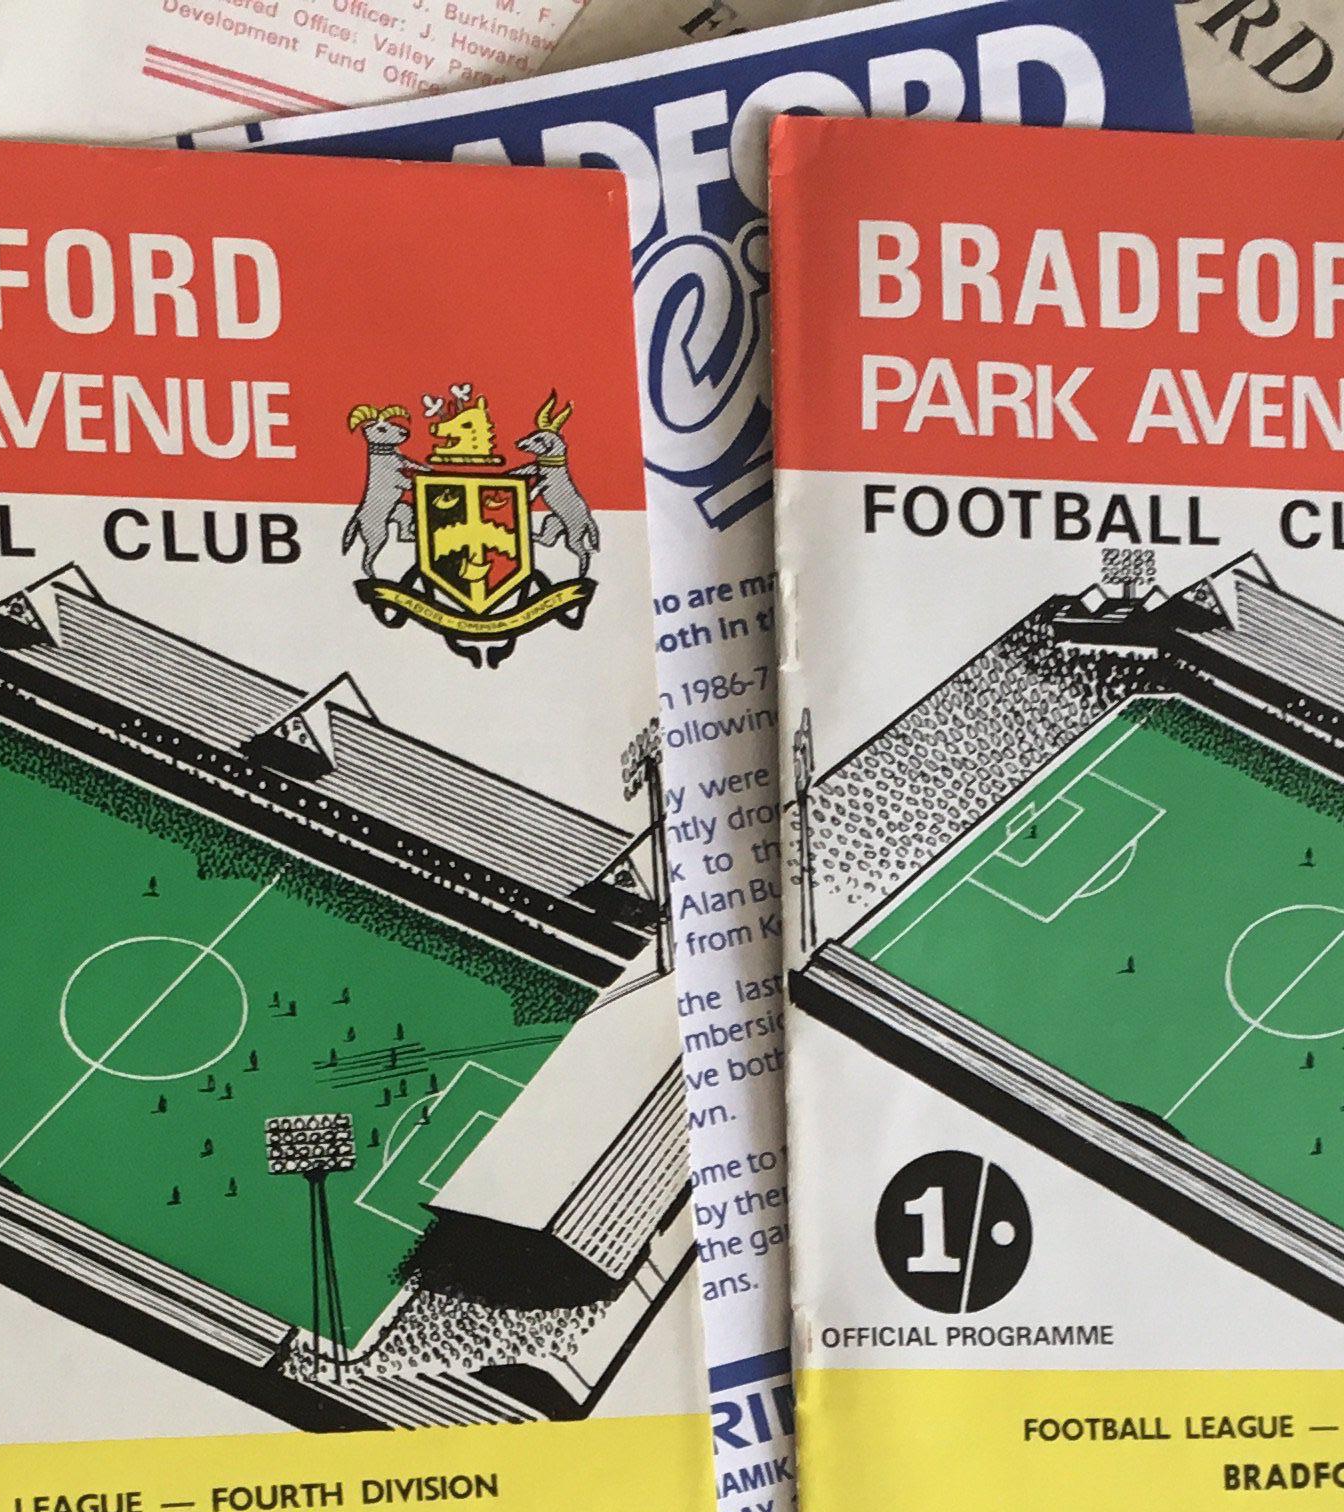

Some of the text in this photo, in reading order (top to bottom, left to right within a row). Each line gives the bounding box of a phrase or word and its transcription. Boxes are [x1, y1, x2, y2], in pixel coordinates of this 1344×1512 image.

[162, 0, 366, 73] Development Fund
[293, 9, 435, 70] Office: Valley
[419, 23, 435, 41] J.
[860, 354, 1096, 442] PARK
[863, 483, 1221, 547] FOOTBALL
[103, 505, 302, 566] CLUB
[688, 583, 733, 608] are
[682, 666, 768, 706] 1986-7
[667, 709, 778, 748] ollowin
[698, 767, 770, 799] were
[702, 852, 734, 875] to
[679, 888, 746, 920] Alan
[686, 925, 752, 956] from
[677, 990, 722, 1017] the
[746, 1151, 777, 1175] to
[694, 1200, 728, 1229] by
[696, 1235, 743, 1264] the
[821, 1323, 1115, 1348] OFFICIAL PROGRAMME
[1023, 1416, 1171, 1443] FOOTBALL
[1185, 1414, 1294, 1441] LEAGUE
[361, 1472, 500, 1508] DIVISION
